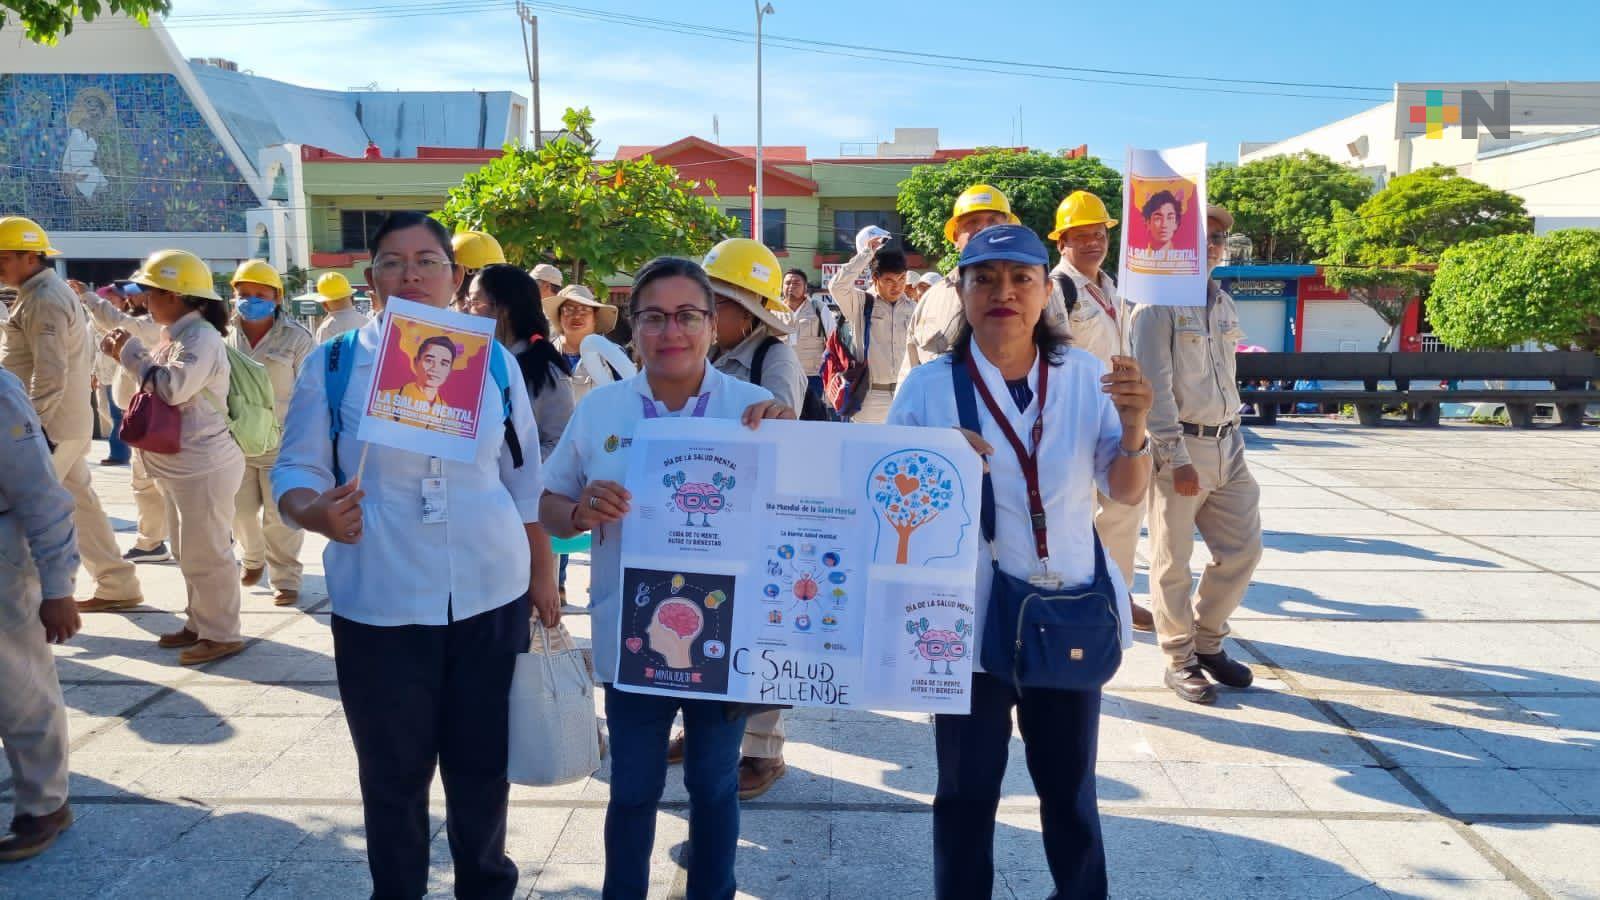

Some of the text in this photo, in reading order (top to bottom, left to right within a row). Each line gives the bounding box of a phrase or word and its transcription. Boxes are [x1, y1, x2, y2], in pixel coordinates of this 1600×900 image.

[1135, 248, 1164, 260] SALUD
[1168, 248, 1197, 261] MENTAL
[375, 390, 391, 403] LA
[393, 394, 430, 412] SALUD
[431, 404, 474, 422] MENTAL
[675, 455, 682, 463] DE
[684, 453, 692, 461] LA
[693, 453, 713, 461] SALUD
[714, 455, 737, 471] MENTAL
[777, 503, 800, 511] Mundial
[818, 505, 833, 514] Salud
[835, 507, 856, 515] Mental
[917, 601, 925, 609] DE
[936, 600, 956, 608] SALUD
[732, 647, 755, 676] C.
[760, 681, 849, 705] ALLENDE
